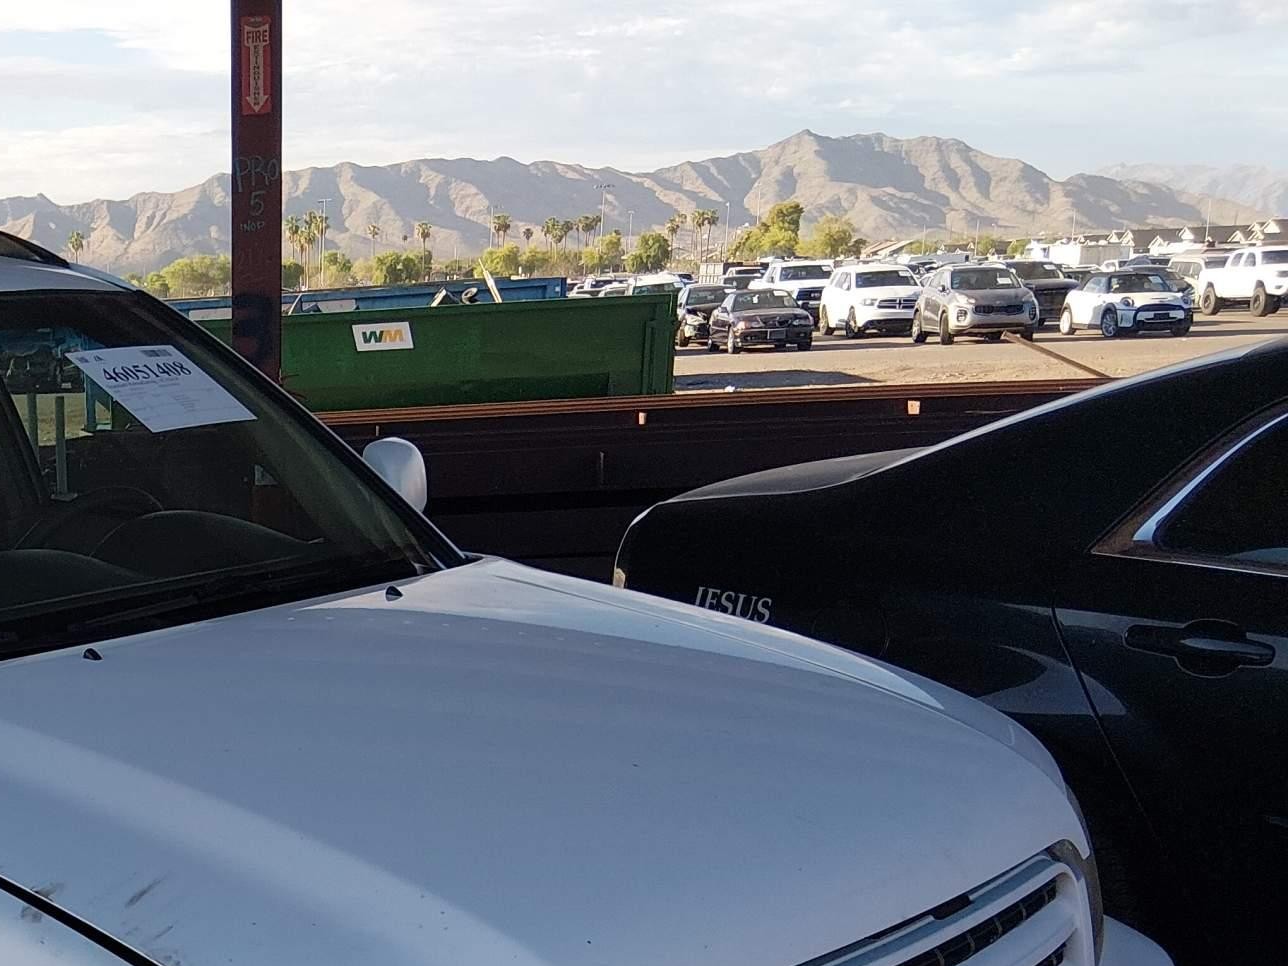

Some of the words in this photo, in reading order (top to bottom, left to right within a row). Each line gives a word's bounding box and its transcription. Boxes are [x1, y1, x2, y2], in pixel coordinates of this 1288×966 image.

[246, 30, 268, 44] FIRE
[249, 190, 266, 217] 5
[361, 328, 404, 344] WM
[102, 360, 192, 383] 46051408
